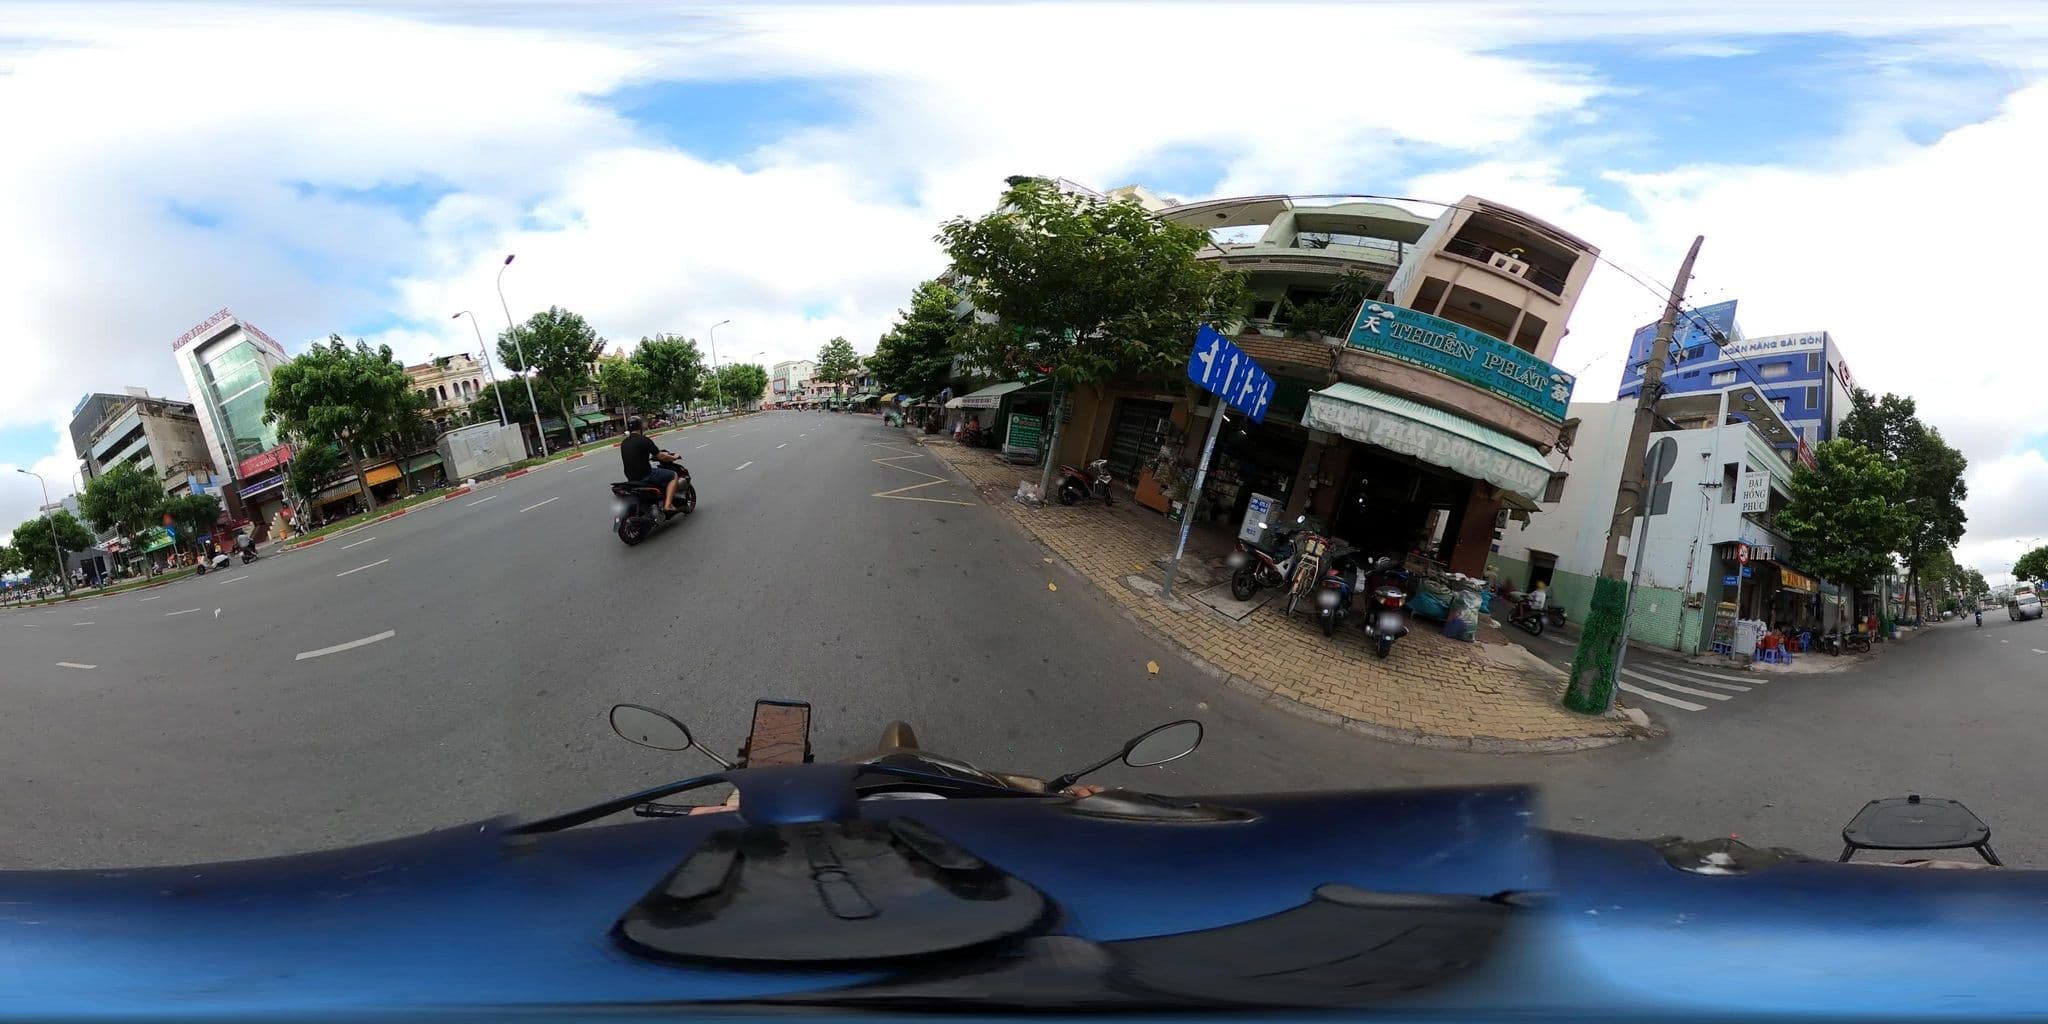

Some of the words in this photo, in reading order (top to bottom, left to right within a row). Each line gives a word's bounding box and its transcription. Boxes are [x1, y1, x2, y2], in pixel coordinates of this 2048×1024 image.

[1359, 316, 1380, 334] 天
[1749, 340, 1777, 351] HÀNG
[1780, 337, 1796, 348] SÀI
[1800, 335, 1822, 345] GÒN
[1390, 320, 1478, 361] THIÊN
[1481, 351, 1549, 392] PHÁT
